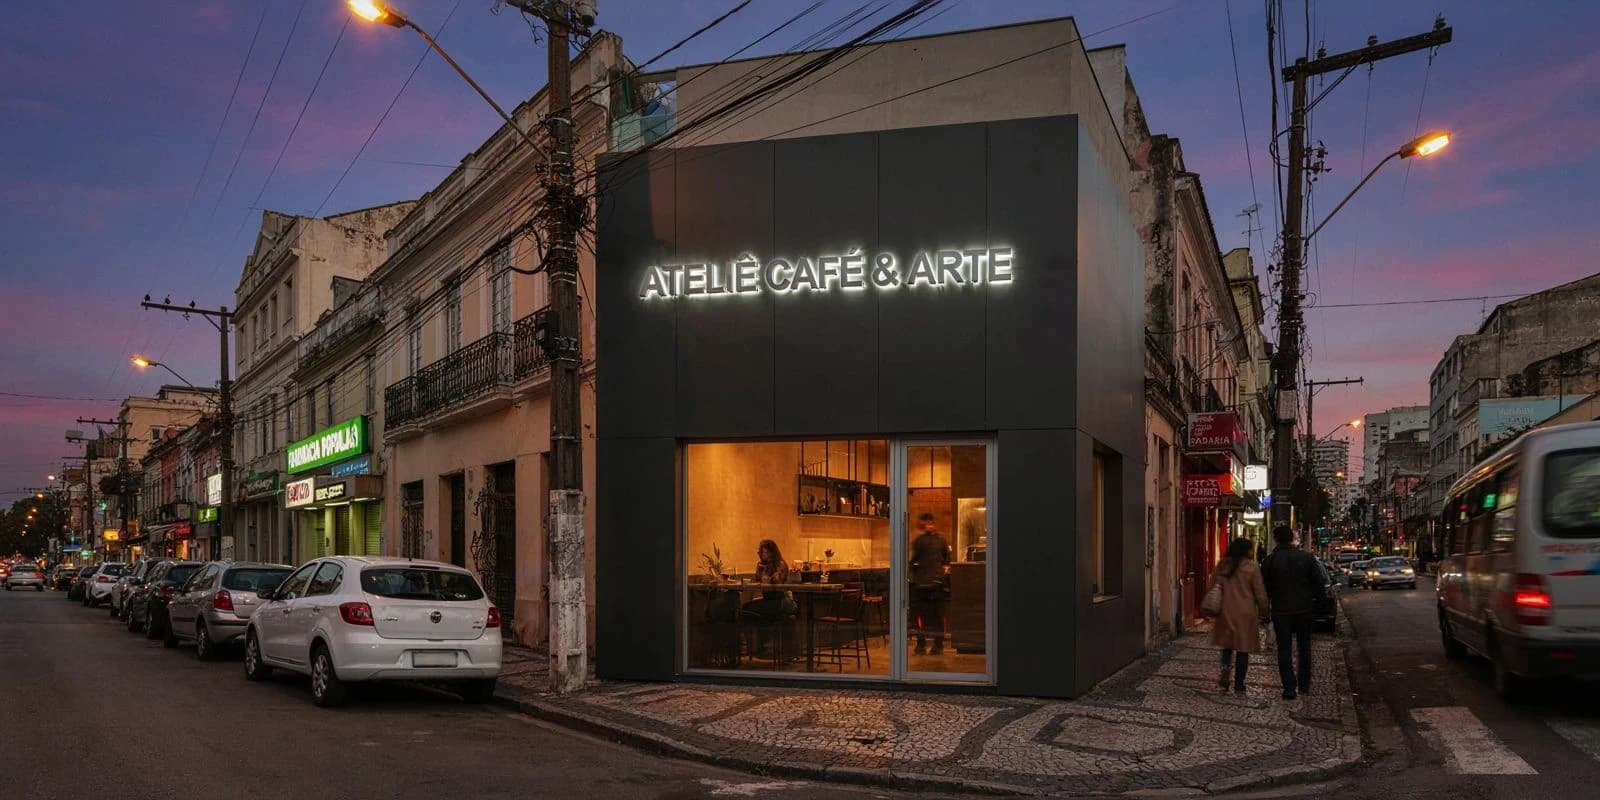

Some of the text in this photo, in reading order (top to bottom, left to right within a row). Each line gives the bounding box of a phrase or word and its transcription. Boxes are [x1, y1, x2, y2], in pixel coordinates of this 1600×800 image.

[639, 247, 1013, 298] ATELIÊ CAFÉ & ARTE
